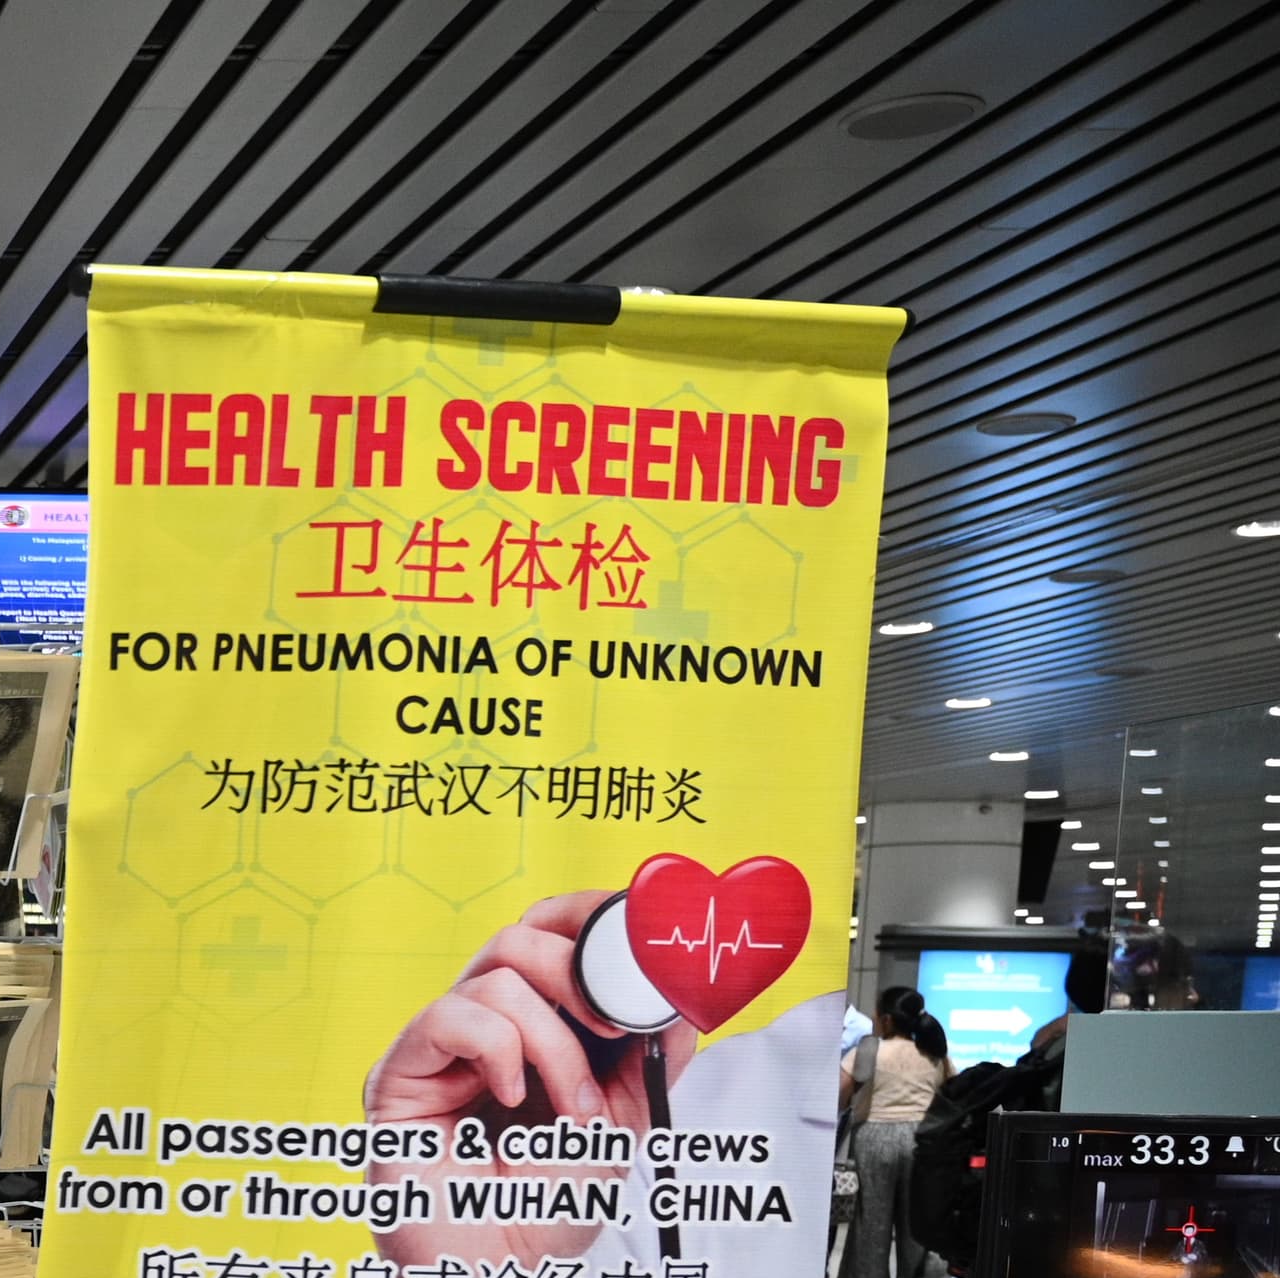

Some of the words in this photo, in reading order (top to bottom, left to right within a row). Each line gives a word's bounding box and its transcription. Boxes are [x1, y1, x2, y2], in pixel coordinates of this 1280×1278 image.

[115, 392, 406, 488] HEALTH
[437, 399, 845, 508] SCREENING
[296, 518, 650, 611] 卫生体检
[110, 632, 198, 672] FOR
[213, 632, 498, 674] PNEUMONIA
[515, 637, 572, 677] OF
[589, 640, 822, 688] UNKNOWN
[396, 695, 543, 737] CAUSE
[201, 758, 706, 824] 为防范武汉不明肺炎
[86, 1112, 145, 1150] All
[162, 1123, 438, 1167] passengers
[456, 1123, 485, 1159] &
[503, 1122, 630, 1161] cabin
[647, 1133, 769, 1163] crews
[1052, 1137, 1069, 1147] 1.0
[1084, 1154, 1123, 1167] max
[1130, 1134, 1210, 1165] 33.3
[59, 1171, 163, 1210] from
[181, 1183, 231, 1212] or
[246, 1176, 429, 1227] through
[449, 1182, 631, 1226] WUHAN,
[649, 1184, 792, 1223] CHINA
